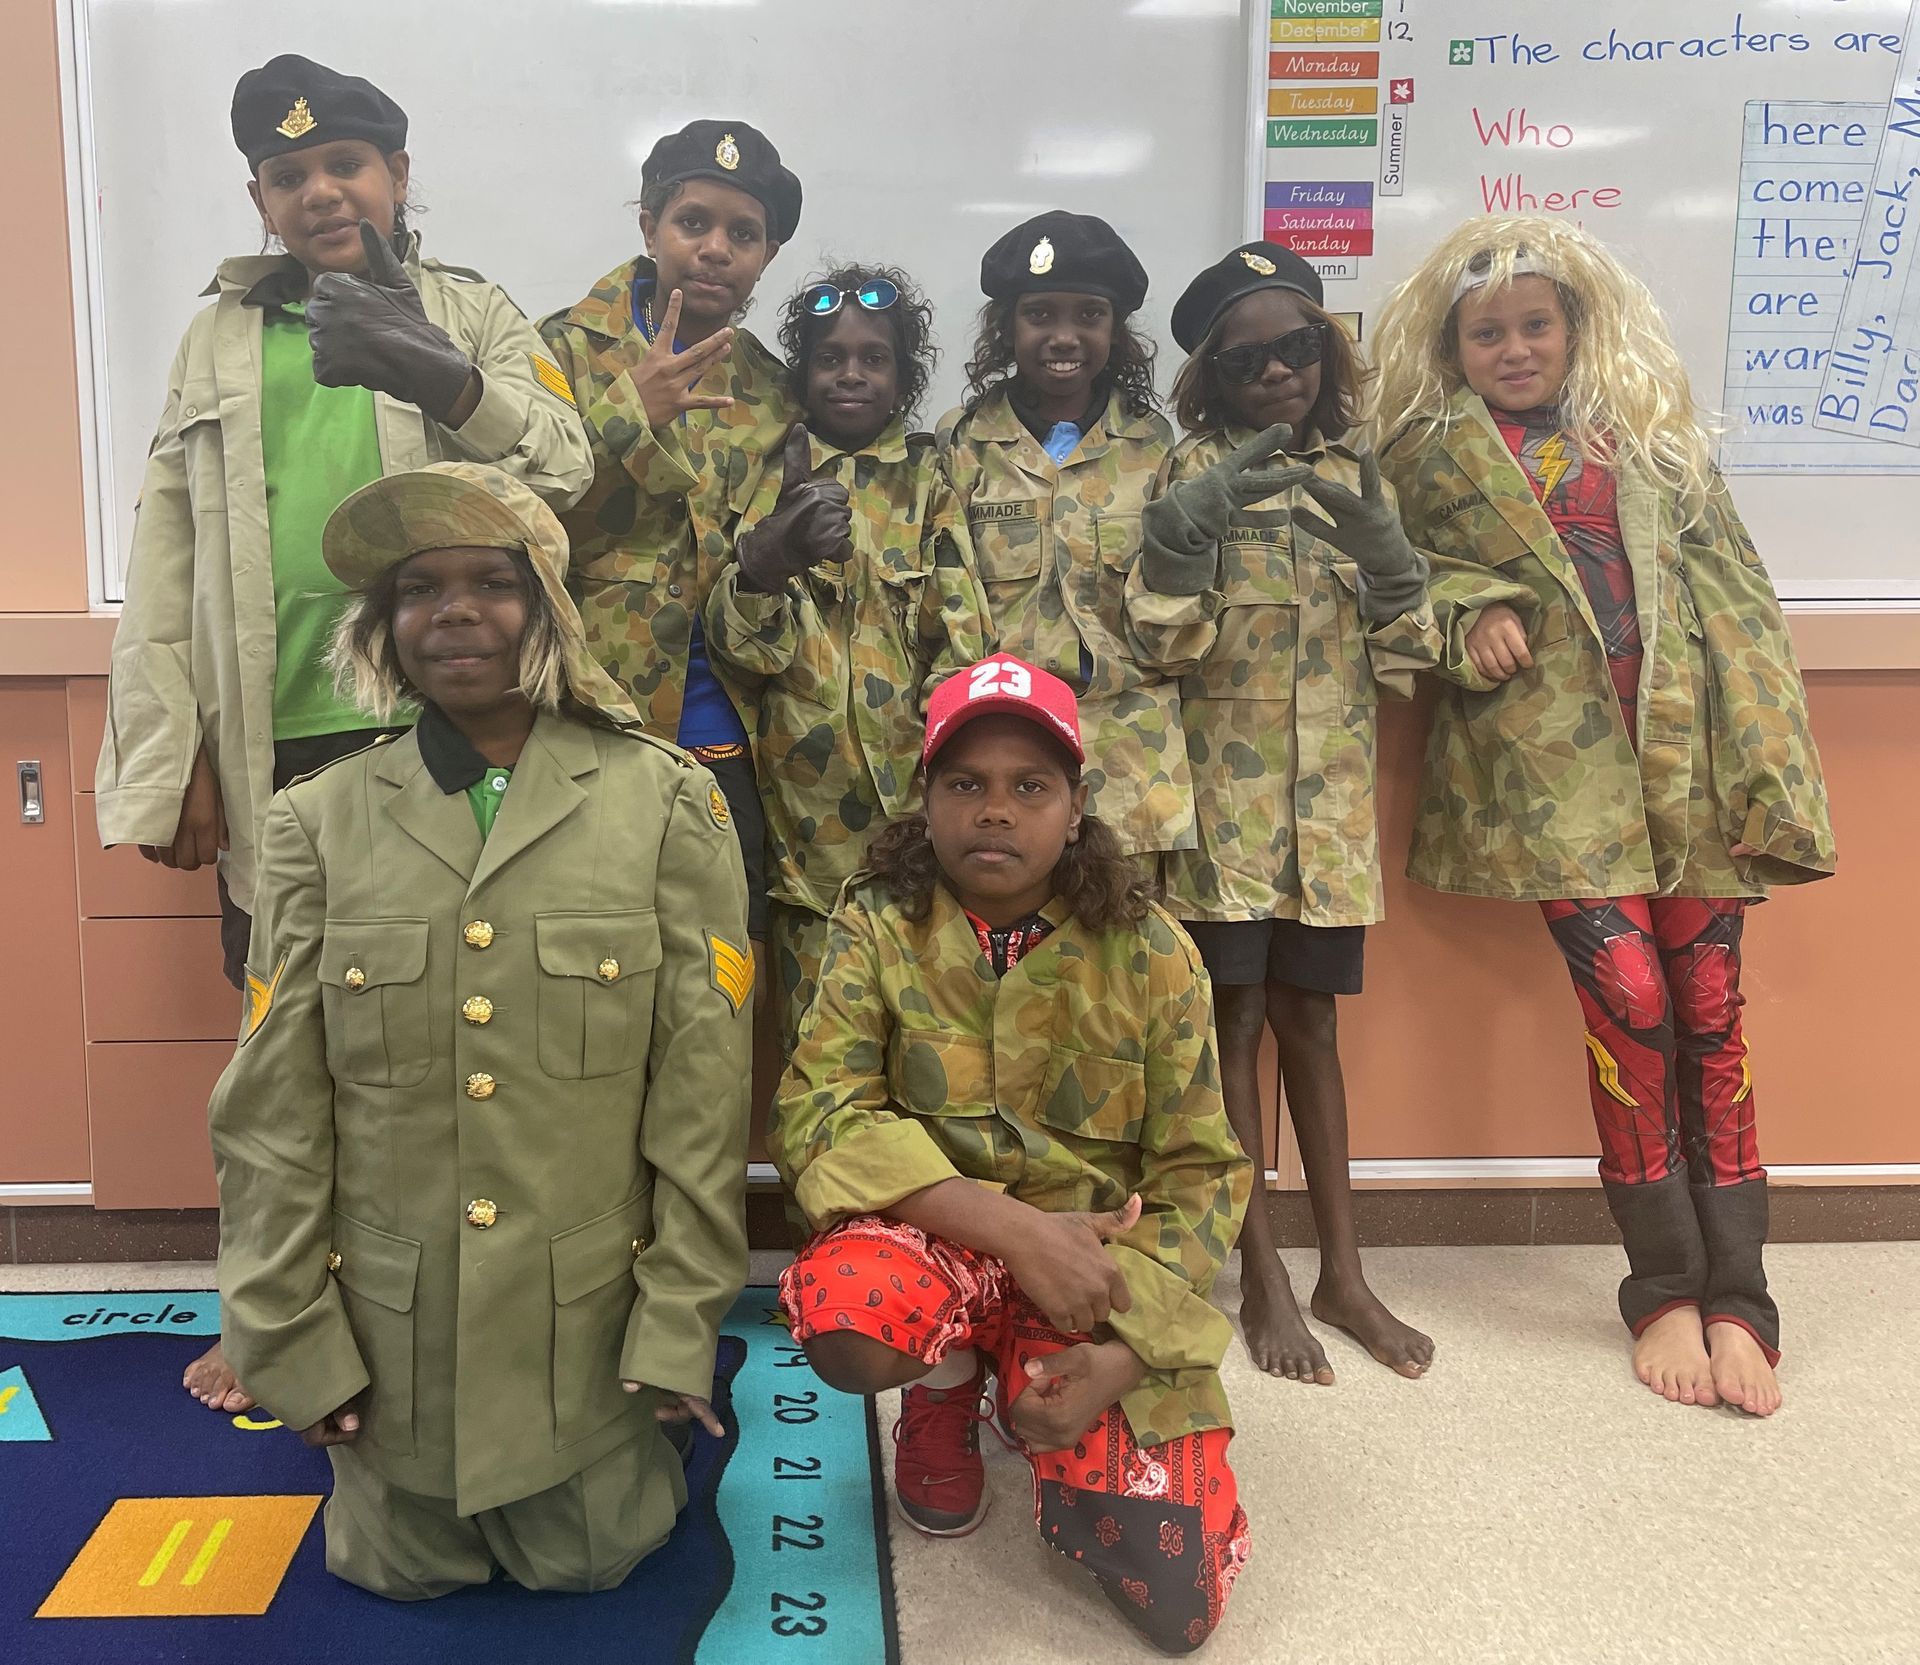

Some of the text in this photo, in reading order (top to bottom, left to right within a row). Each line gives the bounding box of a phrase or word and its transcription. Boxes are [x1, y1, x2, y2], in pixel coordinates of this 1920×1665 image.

[1284, 0, 1369, 13] November
[1280, 21, 1368, 38] December
[1388, 21, 1413, 42] 12
[1475, 14, 1902, 65] The characters are
[1286, 57, 1360, 76] Monday
[1289, 93, 1354, 112] Tuesday
[1274, 124, 1369, 143] Wednesday
[1472, 107, 1574, 149] Who
[1762, 104, 1867, 147] here
[1384, 113, 1403, 185] Summer
[1290, 186, 1346, 206] Friday
[1480, 173, 1622, 213] Where
[1753, 179, 1864, 203] come
[1279, 213, 1356, 231] Saturday
[1851, 166, 1920, 281] Jack,
[1289, 234, 1351, 253] Sunday
[1312, 264, 1347, 275] umn
[1748, 292, 1820, 317] are
[1819, 314, 1893, 423] Billy,
[1747, 404, 1805, 426] was
[970, 503, 1023, 520] MMIADE
[968, 661, 1032, 700] 23
[62, 1303, 198, 1327] circle
[773, 1391, 820, 1424] 20
[773, 1456, 822, 1480] 21
[772, 1514, 825, 1552] 22
[770, 1582, 828, 1637] 23
